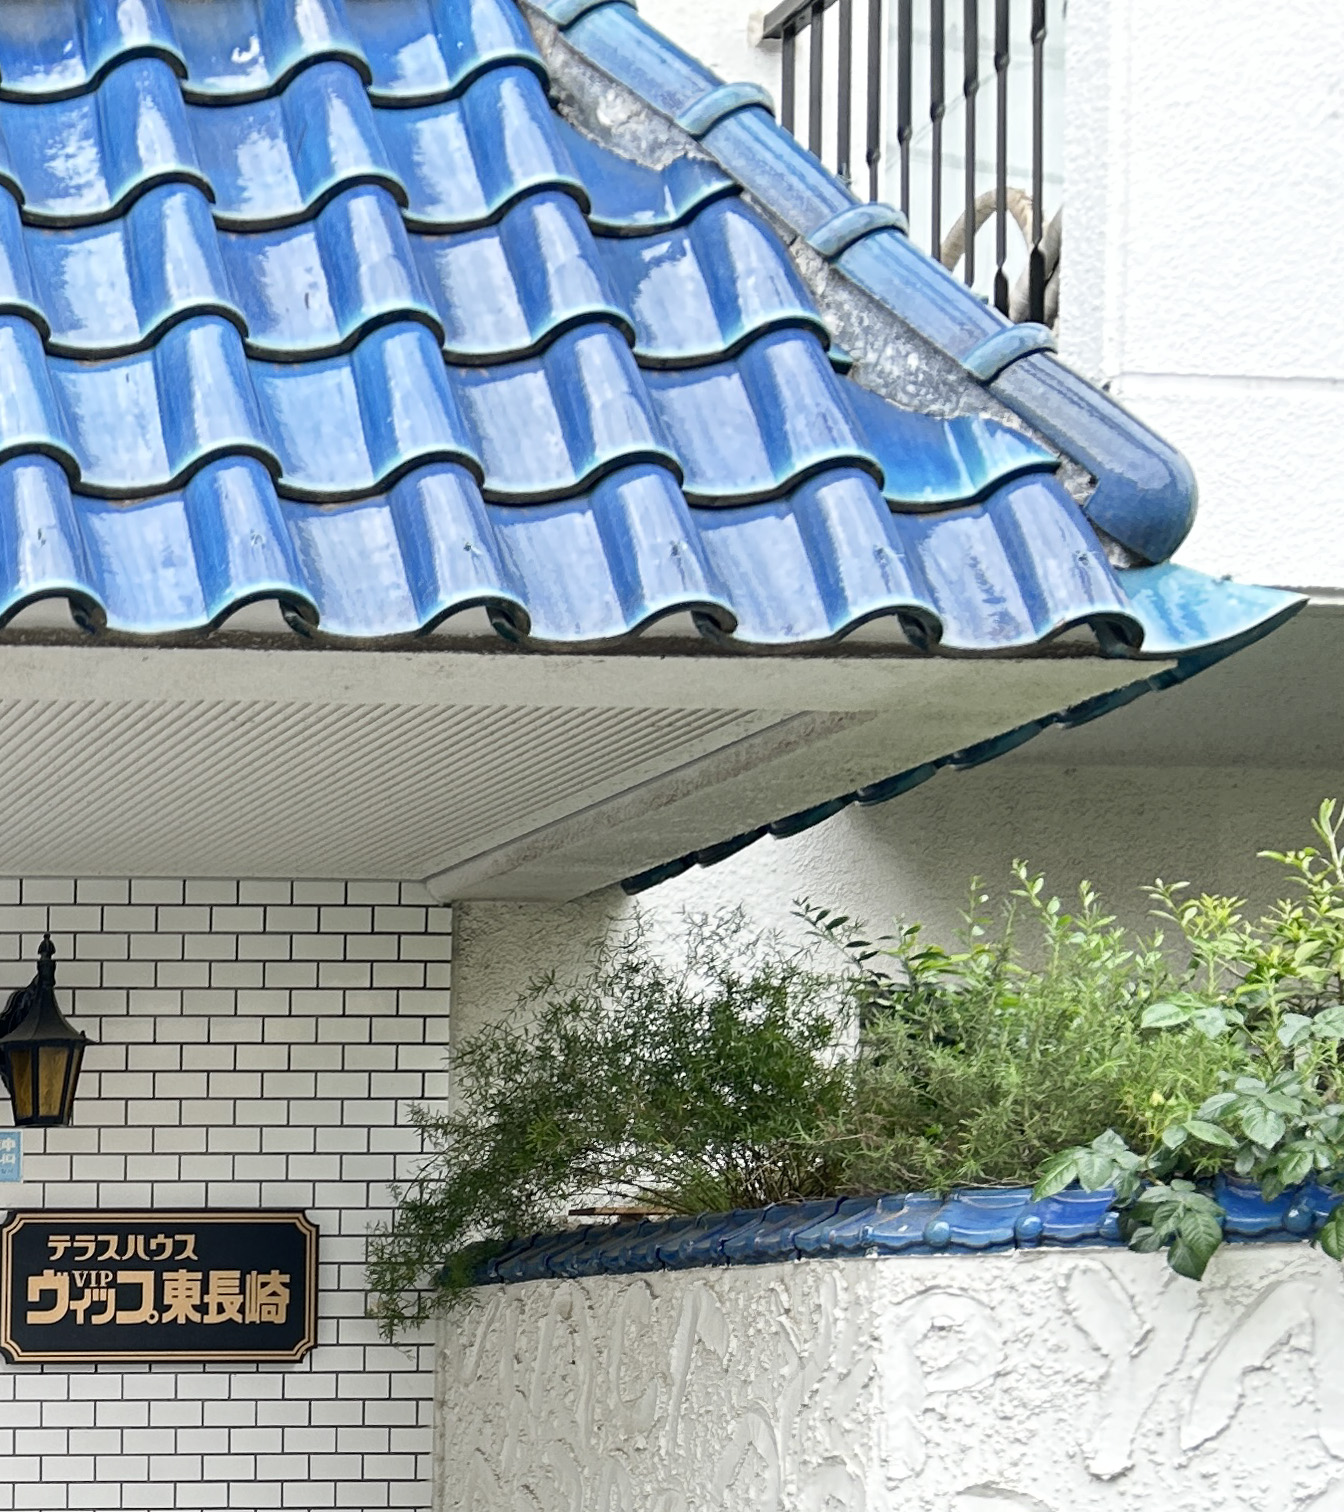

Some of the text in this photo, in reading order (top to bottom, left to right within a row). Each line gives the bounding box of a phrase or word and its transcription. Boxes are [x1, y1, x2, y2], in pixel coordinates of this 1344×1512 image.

[47, 1233, 199, 1261] テラスハウス
[70, 1270, 114, 1288] VIP
